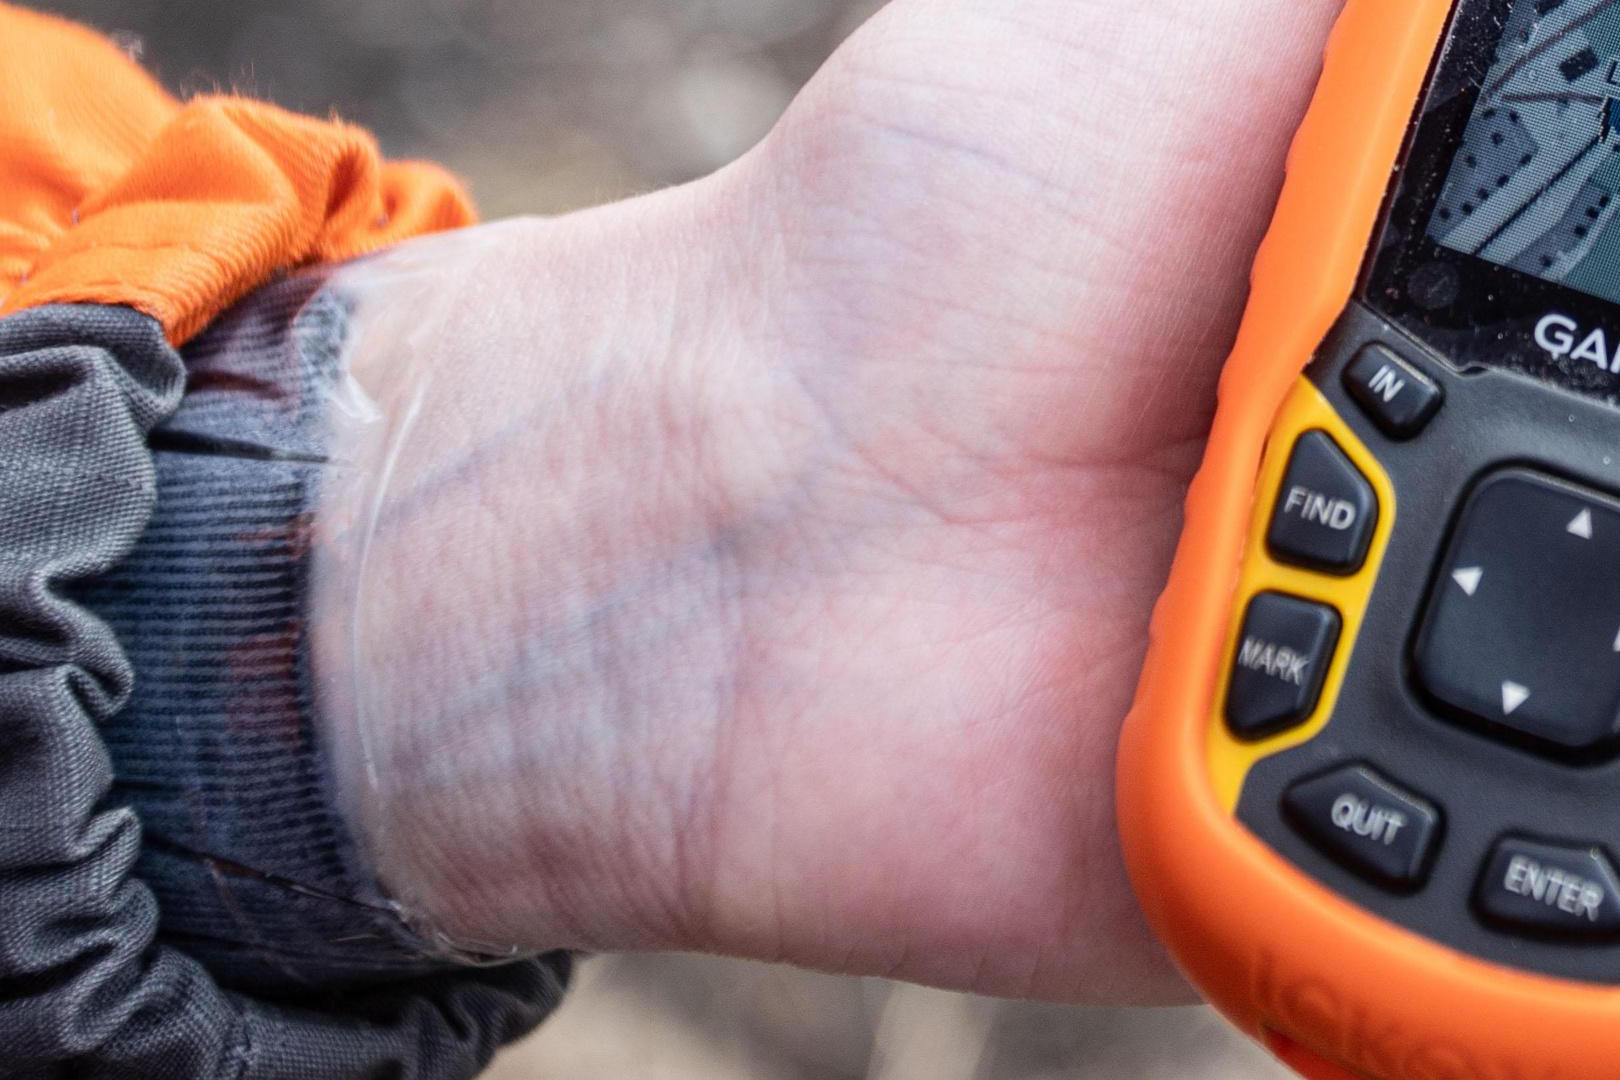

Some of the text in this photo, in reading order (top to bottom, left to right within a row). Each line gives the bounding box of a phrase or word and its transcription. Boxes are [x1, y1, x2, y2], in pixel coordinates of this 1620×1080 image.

[1369, 366, 1404, 403] IN
[1285, 488, 1355, 530] FIND
[1239, 637, 1308, 686] MARK
[1331, 794, 1403, 844] QUIT
[1504, 858, 1602, 919] ENTER
